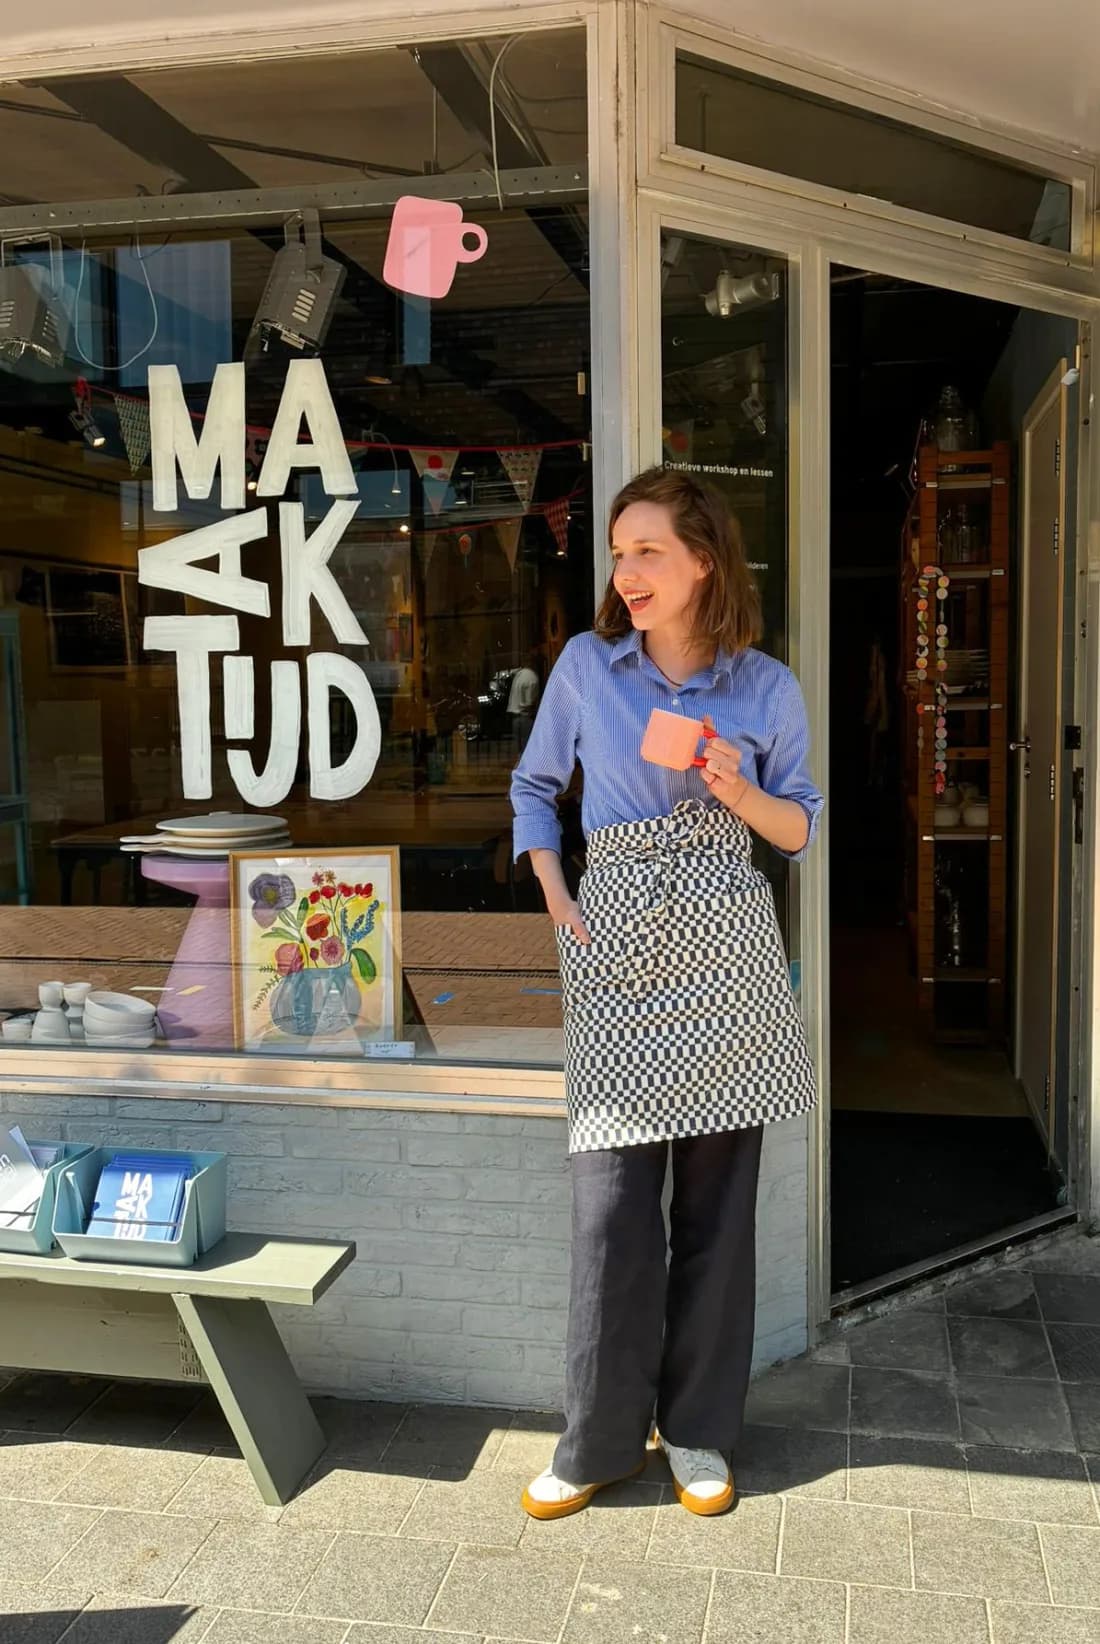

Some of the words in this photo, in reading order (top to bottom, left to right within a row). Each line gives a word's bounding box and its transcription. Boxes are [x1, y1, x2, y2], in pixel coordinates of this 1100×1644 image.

[148, 358, 359, 511] MA
[664, 461, 701, 472] Creatieve
[703, 464, 738, 476] workshop
[740, 468, 749, 476] en
[750, 467, 773, 477] lessen
[138, 500, 369, 647] AK
[143, 615, 381, 808] TIJD
[121, 1171, 153, 1197] MA
